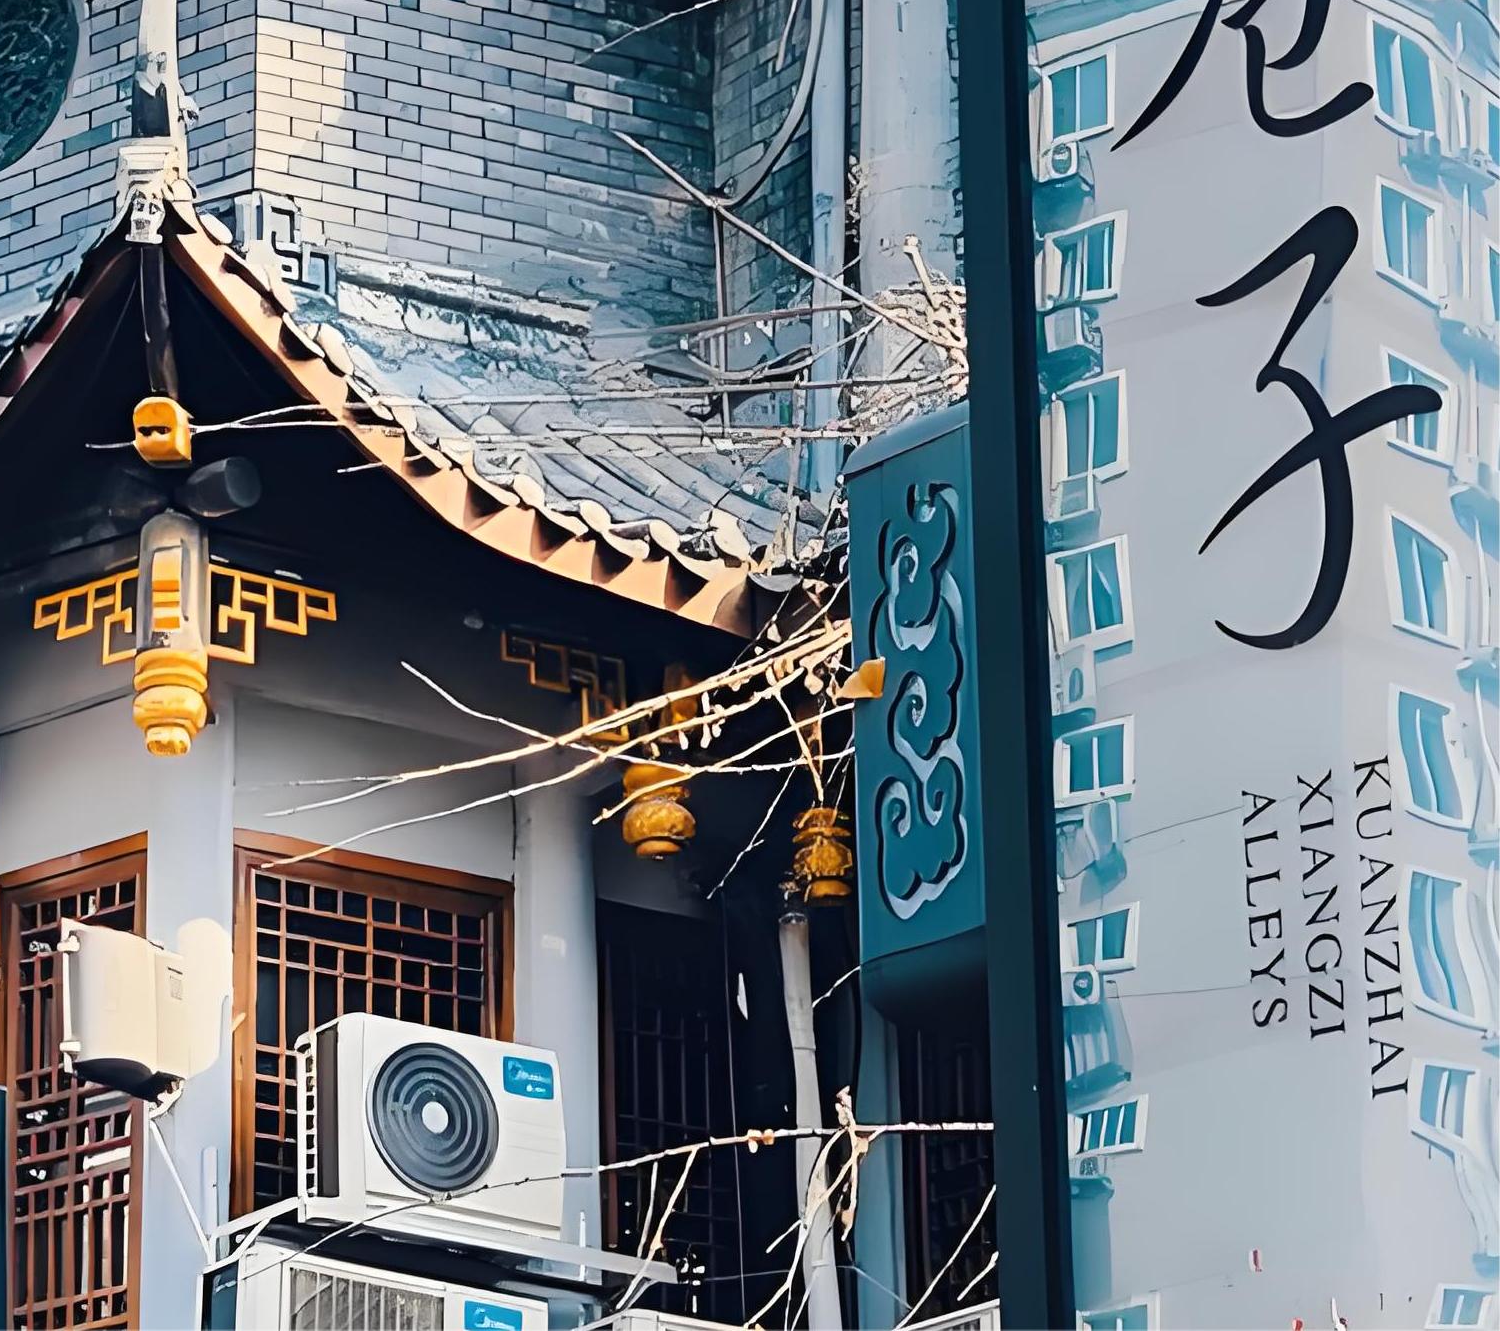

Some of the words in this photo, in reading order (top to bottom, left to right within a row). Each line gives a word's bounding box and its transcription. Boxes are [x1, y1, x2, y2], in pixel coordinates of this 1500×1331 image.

[1241, 790, 1288, 1028] ALLEYS
[1296, 769, 1346, 1039] XIANGZI
[1353, 755, 1409, 1100] KUANZHAI
